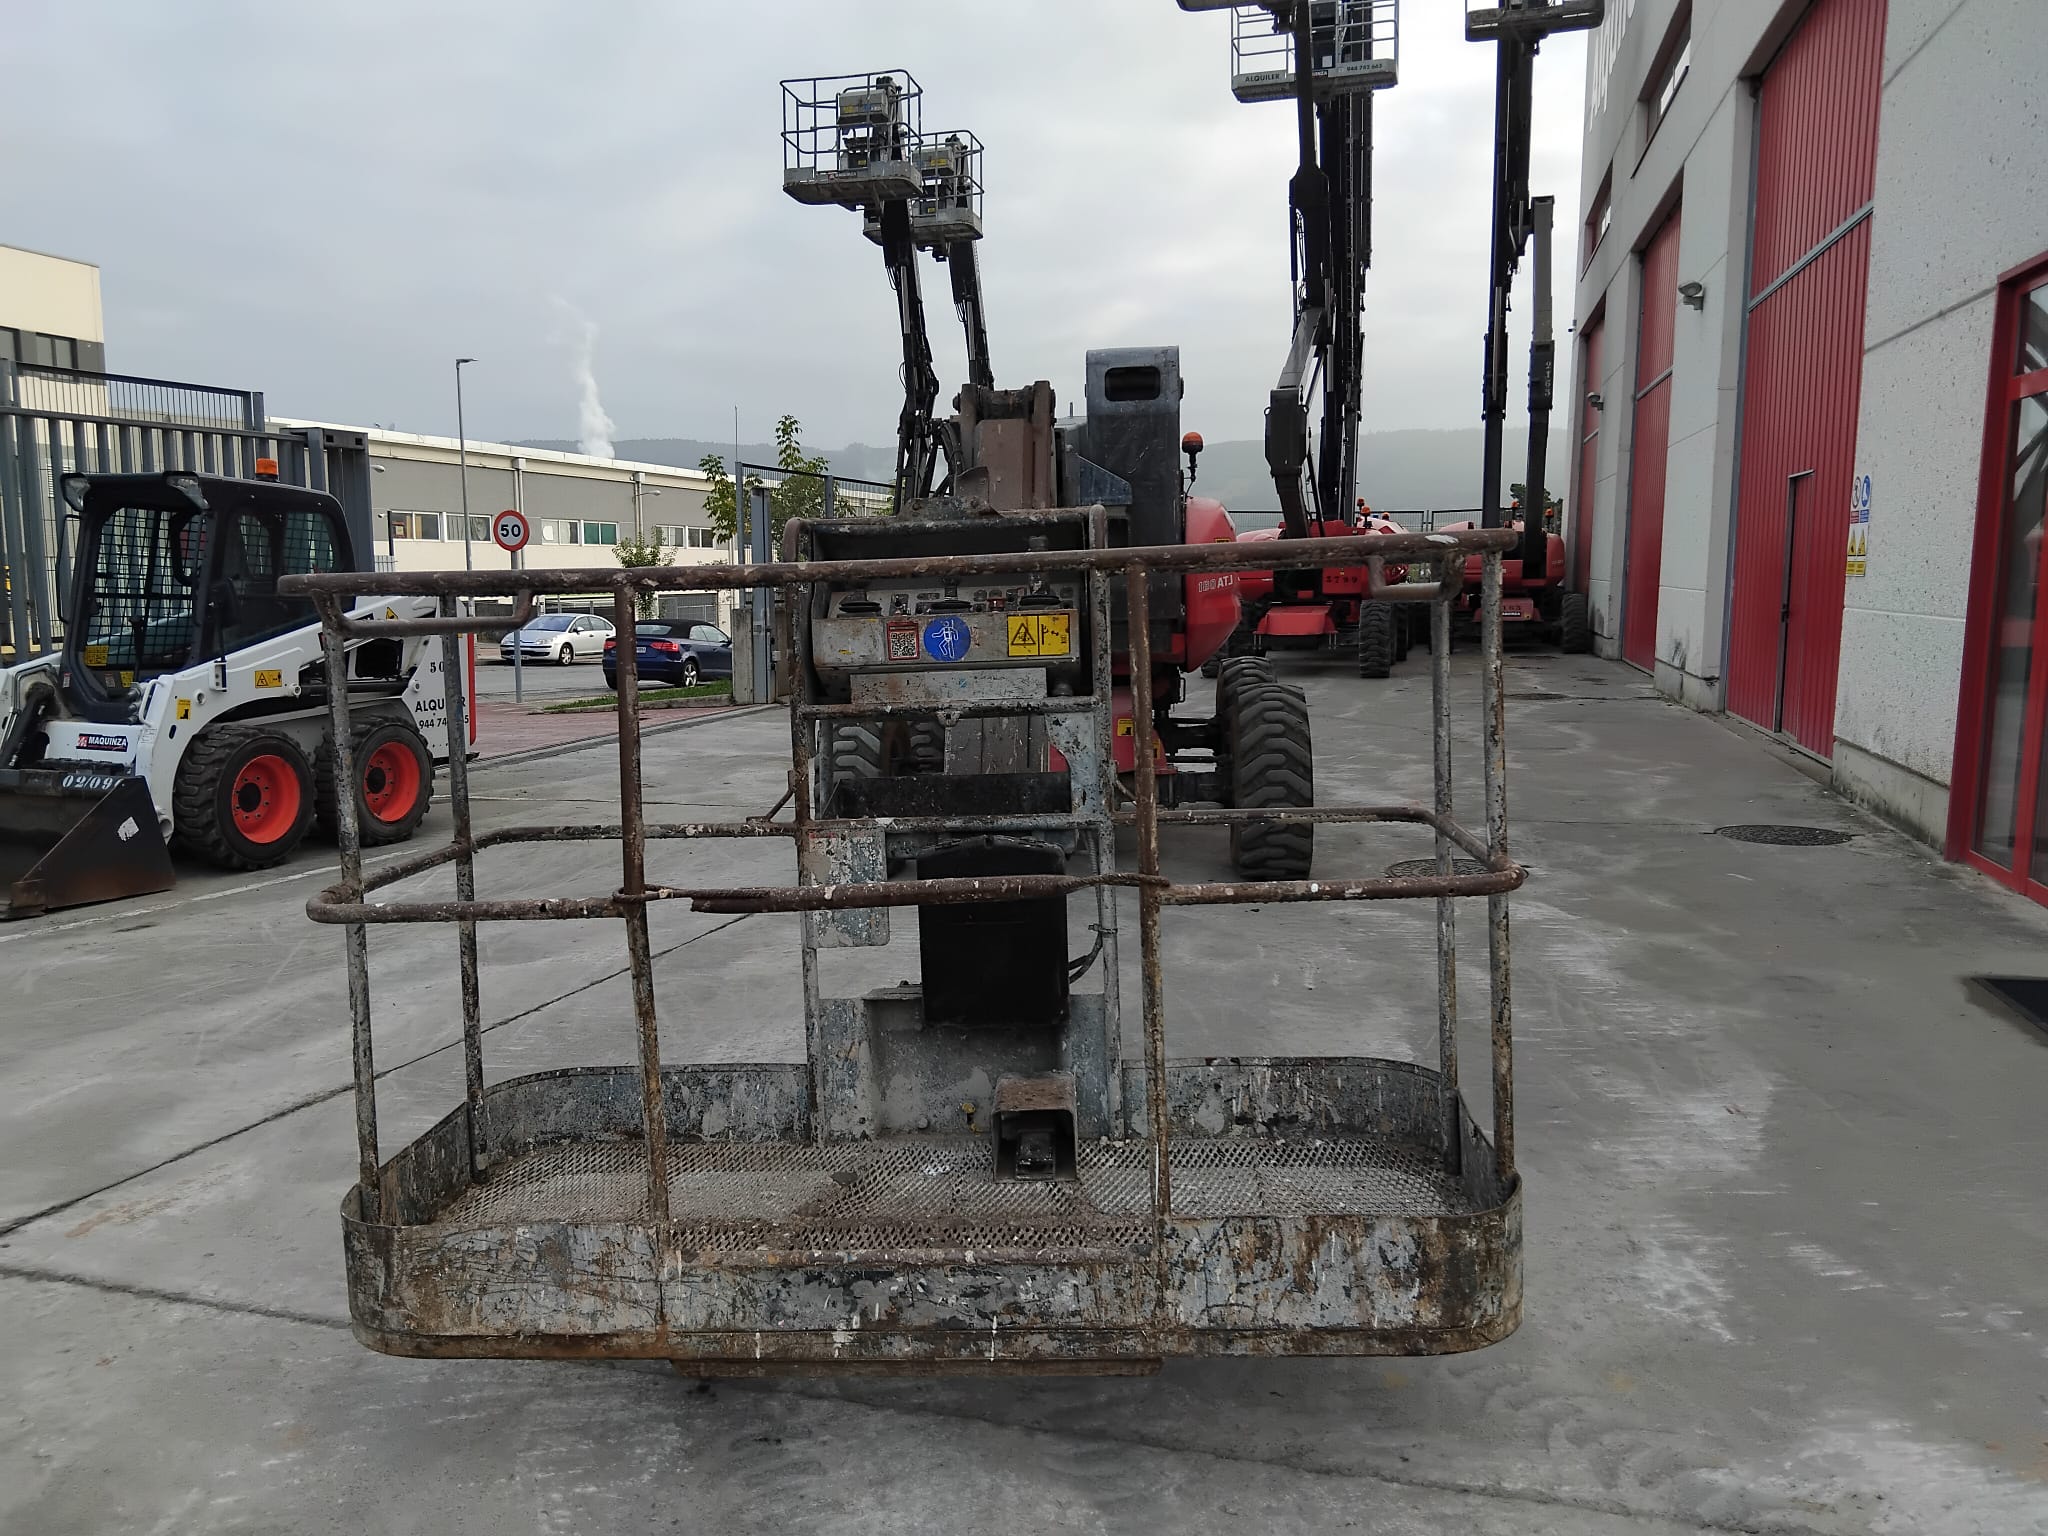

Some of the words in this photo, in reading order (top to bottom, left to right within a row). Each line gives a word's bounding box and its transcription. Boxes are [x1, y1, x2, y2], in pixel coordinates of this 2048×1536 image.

[1245, 73, 1280, 82] ALQUILER
[500, 523, 521, 538] 50
[88, 736, 127, 746] MAQUINZA
